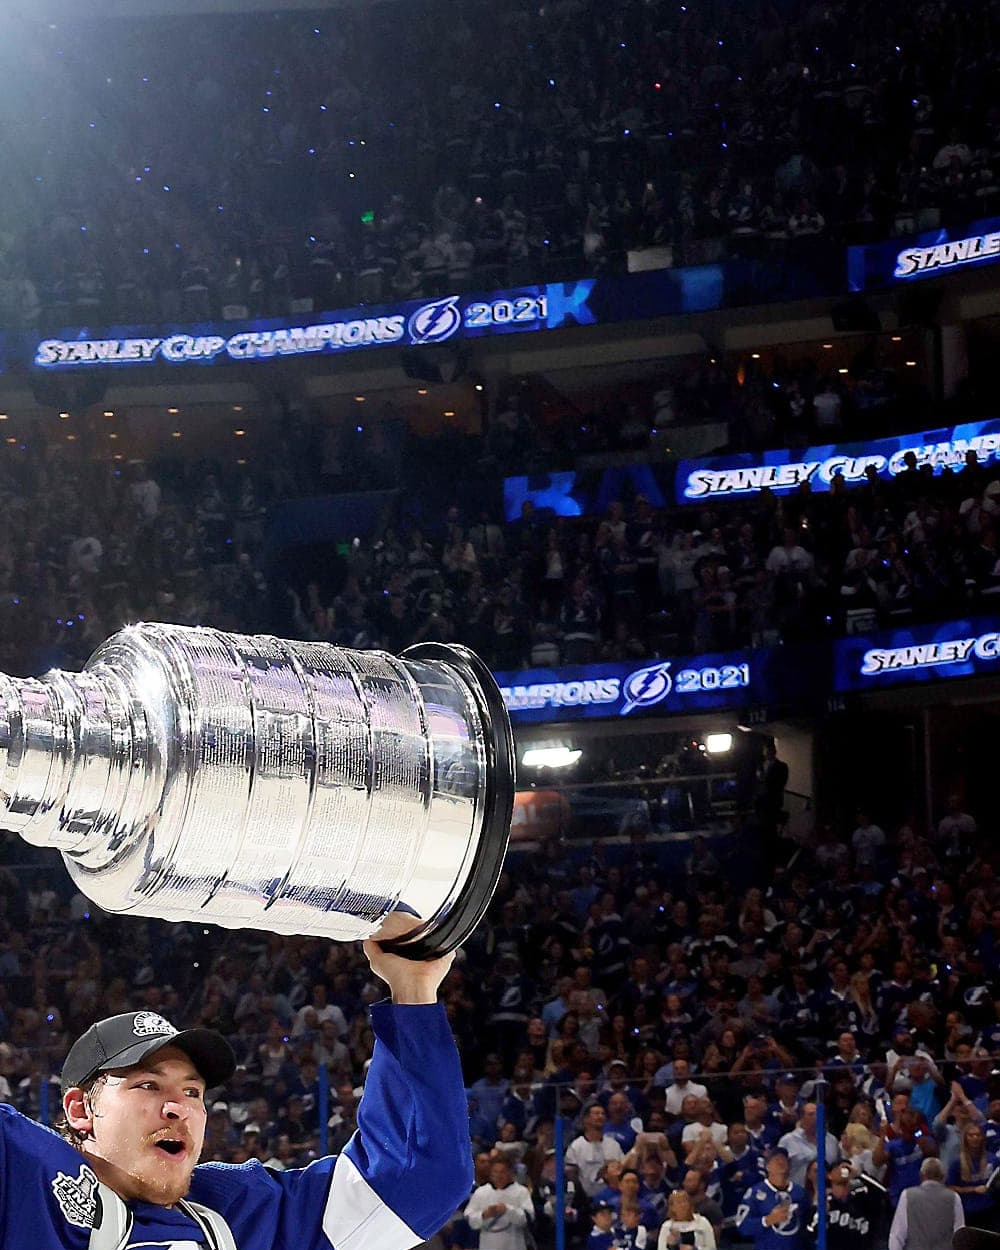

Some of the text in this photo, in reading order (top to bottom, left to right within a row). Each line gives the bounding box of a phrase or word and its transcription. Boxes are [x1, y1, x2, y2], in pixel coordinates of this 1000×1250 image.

[36, 298, 548, 366] STANLEY CUP CHAMPIONS 2021
[683, 462, 820, 499] STANLEY
[820, 455, 888, 484] CUP
[674, 662, 751, 692] 2021
[860, 638, 977, 676] STANLEY
